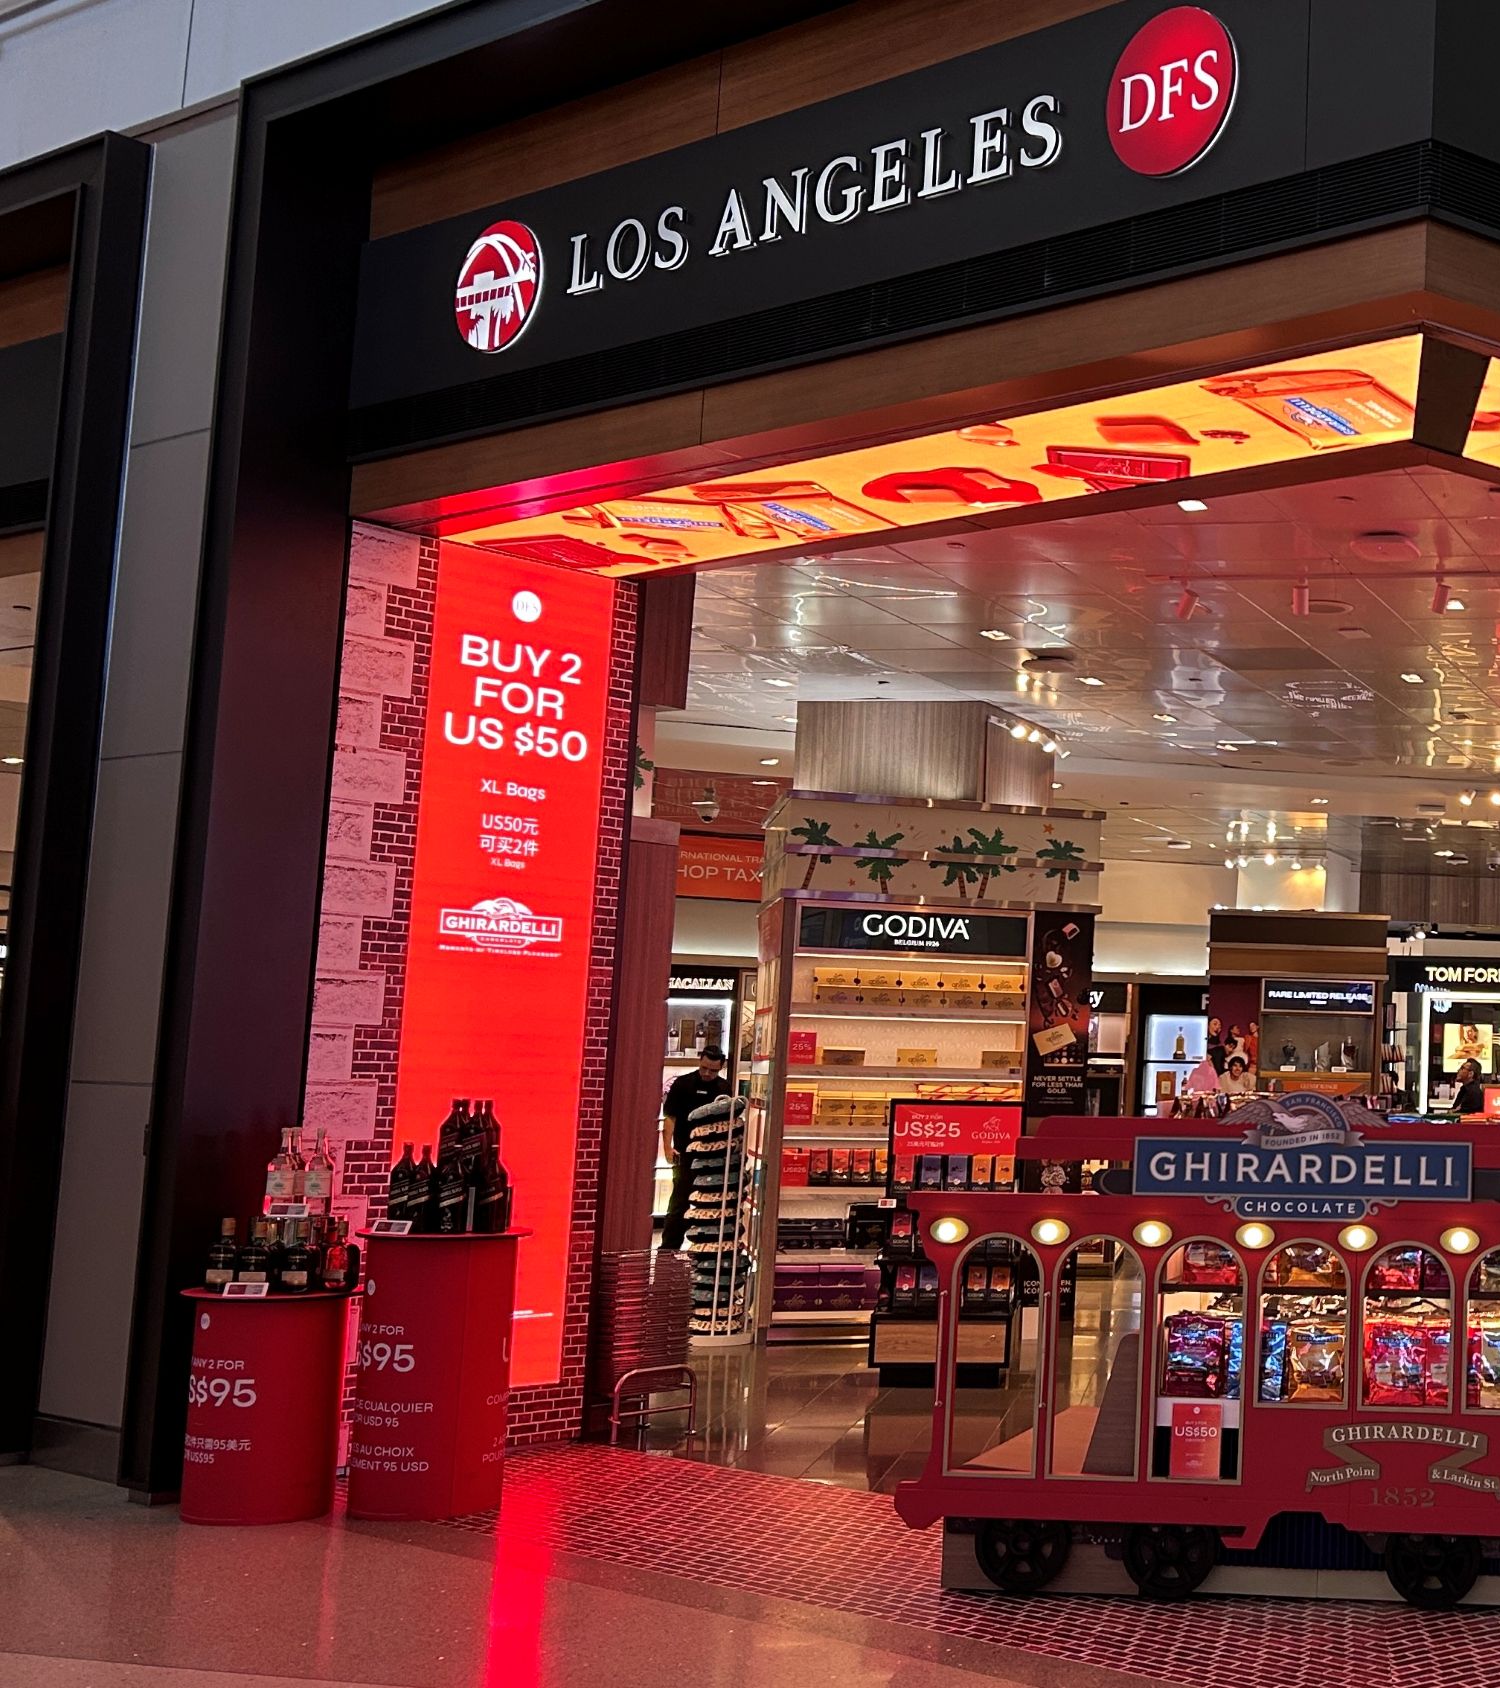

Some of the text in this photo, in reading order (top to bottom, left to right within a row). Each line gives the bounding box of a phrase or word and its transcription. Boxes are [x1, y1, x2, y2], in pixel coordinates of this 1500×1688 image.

[1117, 47, 1222, 134] DFS
[567, 94, 1063, 296] LOS ANGELES
[461, 634, 582, 685] BUY 2
[474, 676, 564, 721] FOR
[443, 711, 588, 762] US $50
[480, 778, 546, 803] XL Bags
[481, 813, 540, 836] US50元
[479, 833, 540, 857] 可买2件
[446, 916, 556, 935] GHIRARDELLI
[863, 914, 970, 940] GODIVA
[1425, 967, 1462, 982] TOM
[1285, 1097, 1343, 1127] SAN FRANCISCO
[894, 1121, 961, 1138] US$25
[971, 1131, 1011, 1140] GODIVA
[1265, 1135, 1307, 1147] FOUNDED
[1322, 1133, 1341, 1141] 1852
[1150, 1151, 1454, 1187] GHIRARDELLI
[1244, 1201, 1356, 1215] CHOCOLATE
[380, 1325, 404, 1335] FOR
[208, 1359, 245, 1370] 2 FOR
[365, 1400, 433, 1414] CUALQUIER
[364, 1416, 399, 1427] USD 95
[1175, 1426, 1217, 1437] US$50
[1332, 1425, 1479, 1449] GHIRARDELLI
[360, 1445, 414, 1457] AU CHOIX
[383, 1462, 429, 1472] 95 USD
[1310, 1466, 1375, 1483] North Point
[1432, 1469, 1499, 1489] & Larkin St.
[1371, 1487, 1436, 1507] 1852
